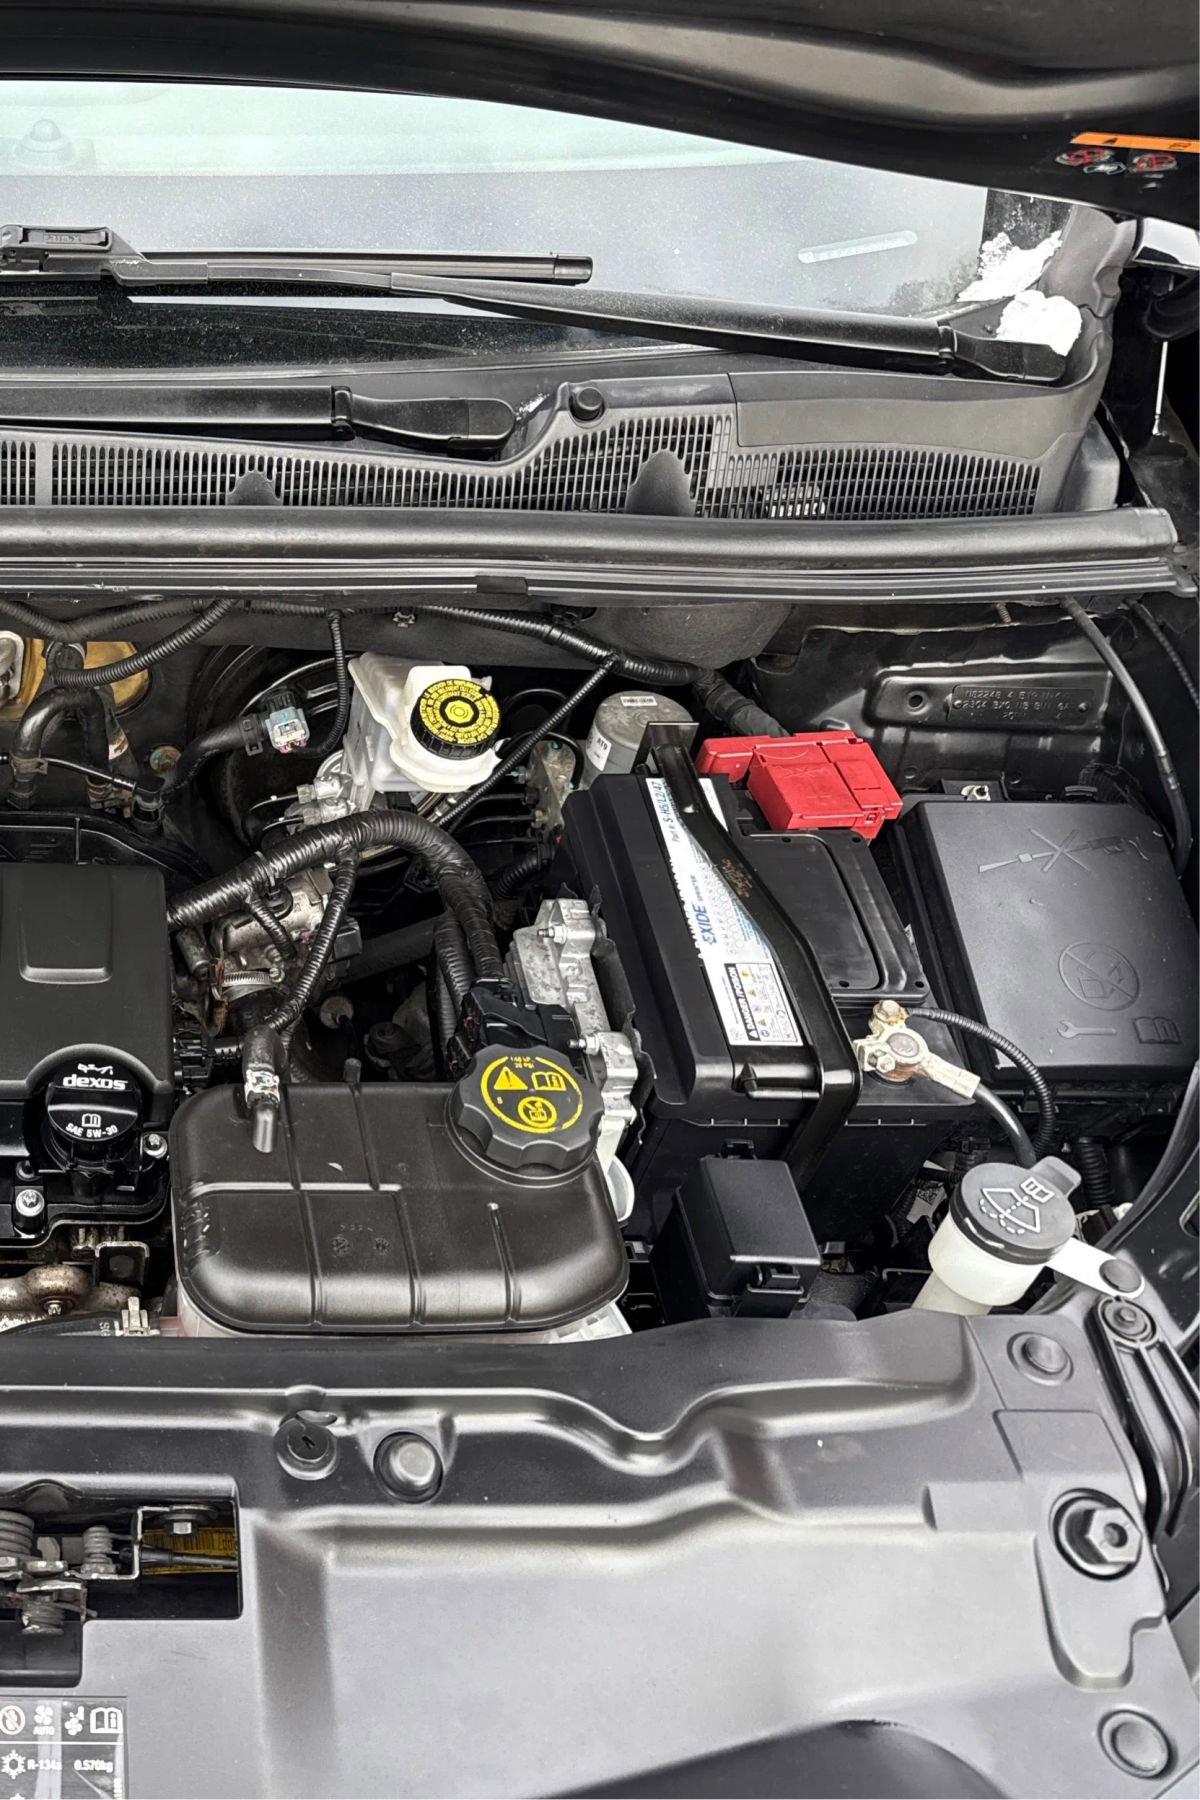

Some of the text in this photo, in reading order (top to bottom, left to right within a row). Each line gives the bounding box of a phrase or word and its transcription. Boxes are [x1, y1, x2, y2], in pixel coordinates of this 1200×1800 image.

[692, 903, 717, 945] EXIDE
[738, 998, 755, 1030] DANGER
[62, 1074, 128, 1090] dexos
[65, 1123, 118, 1138] SAE 5W-30
[32, 1726, 55, 1735] AUTO
[27, 1759, 113, 1773] R-134a 0.570kg
